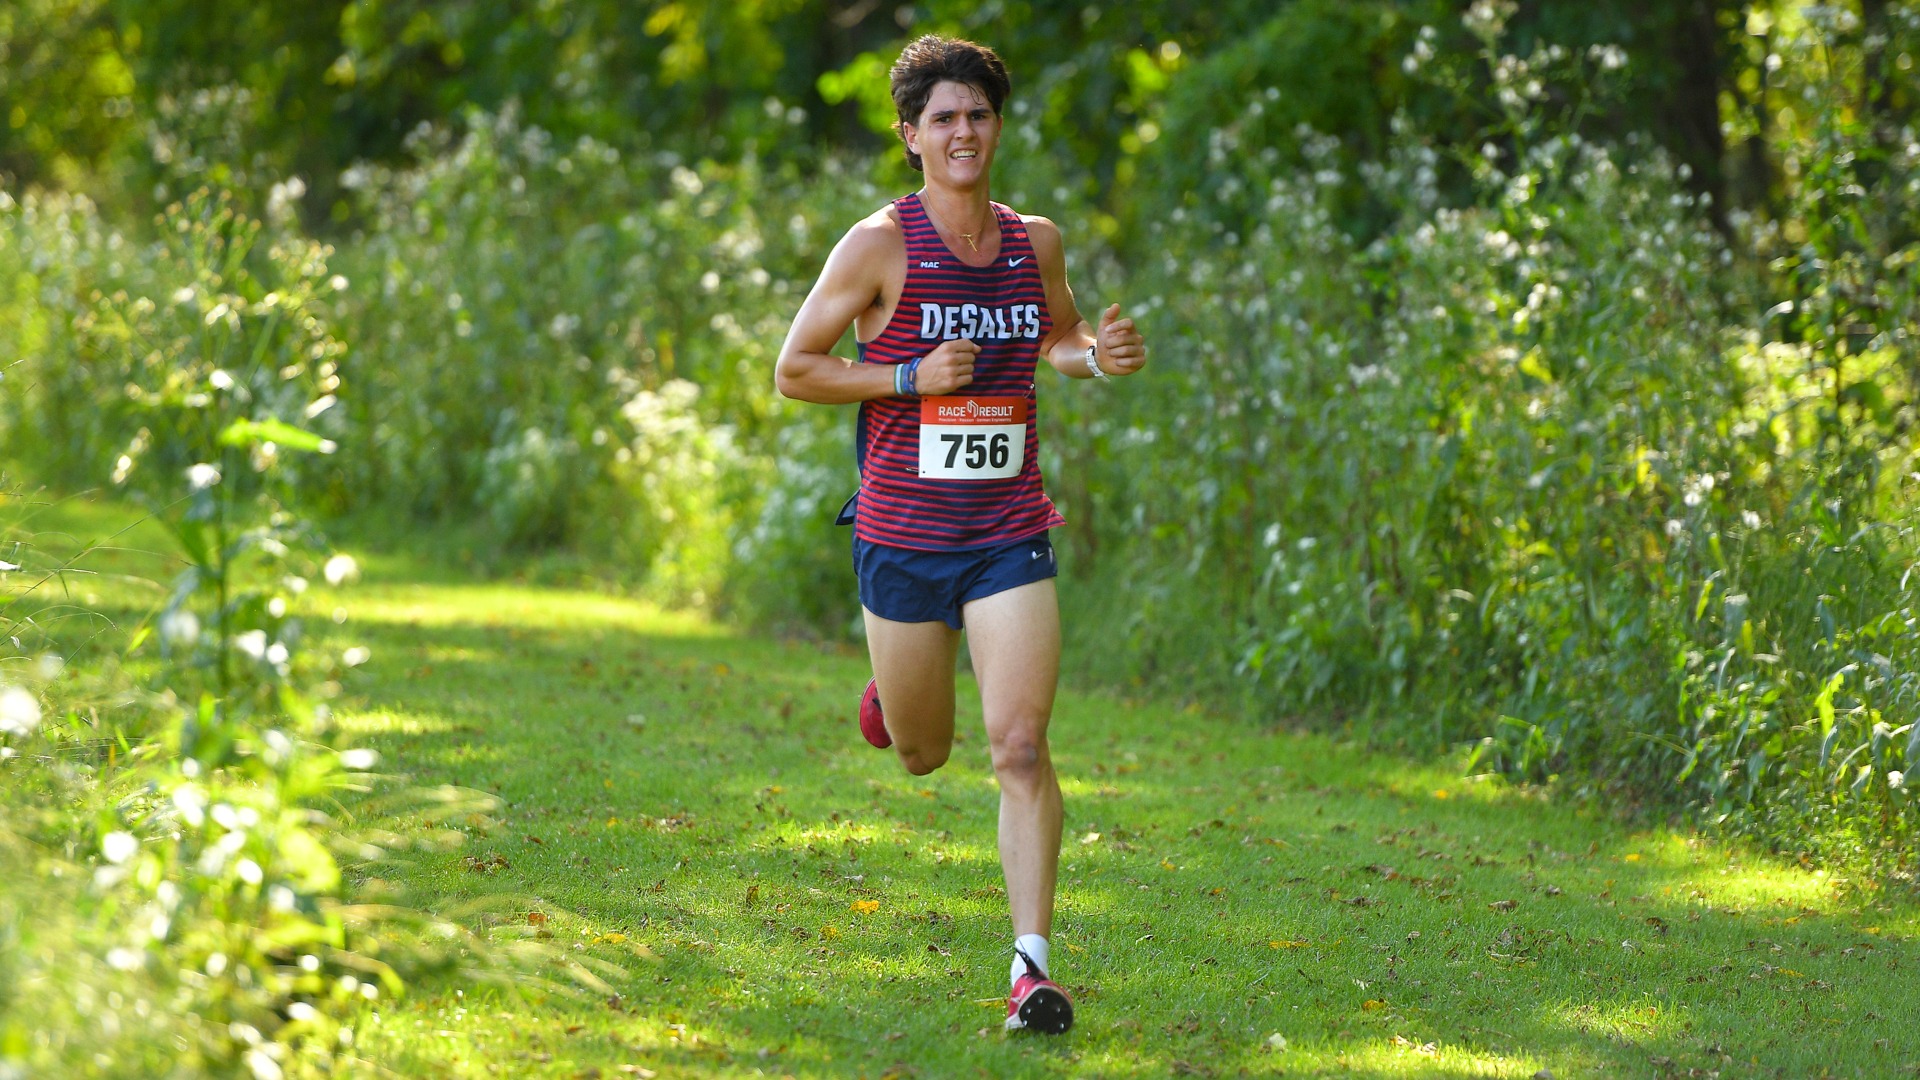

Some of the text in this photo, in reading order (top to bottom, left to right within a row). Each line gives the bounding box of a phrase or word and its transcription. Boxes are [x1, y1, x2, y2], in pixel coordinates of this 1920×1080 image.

[920, 303, 1040, 340] DESALES
[938, 406, 1014, 417] RACE RESULT
[941, 433, 1009, 469] 756
